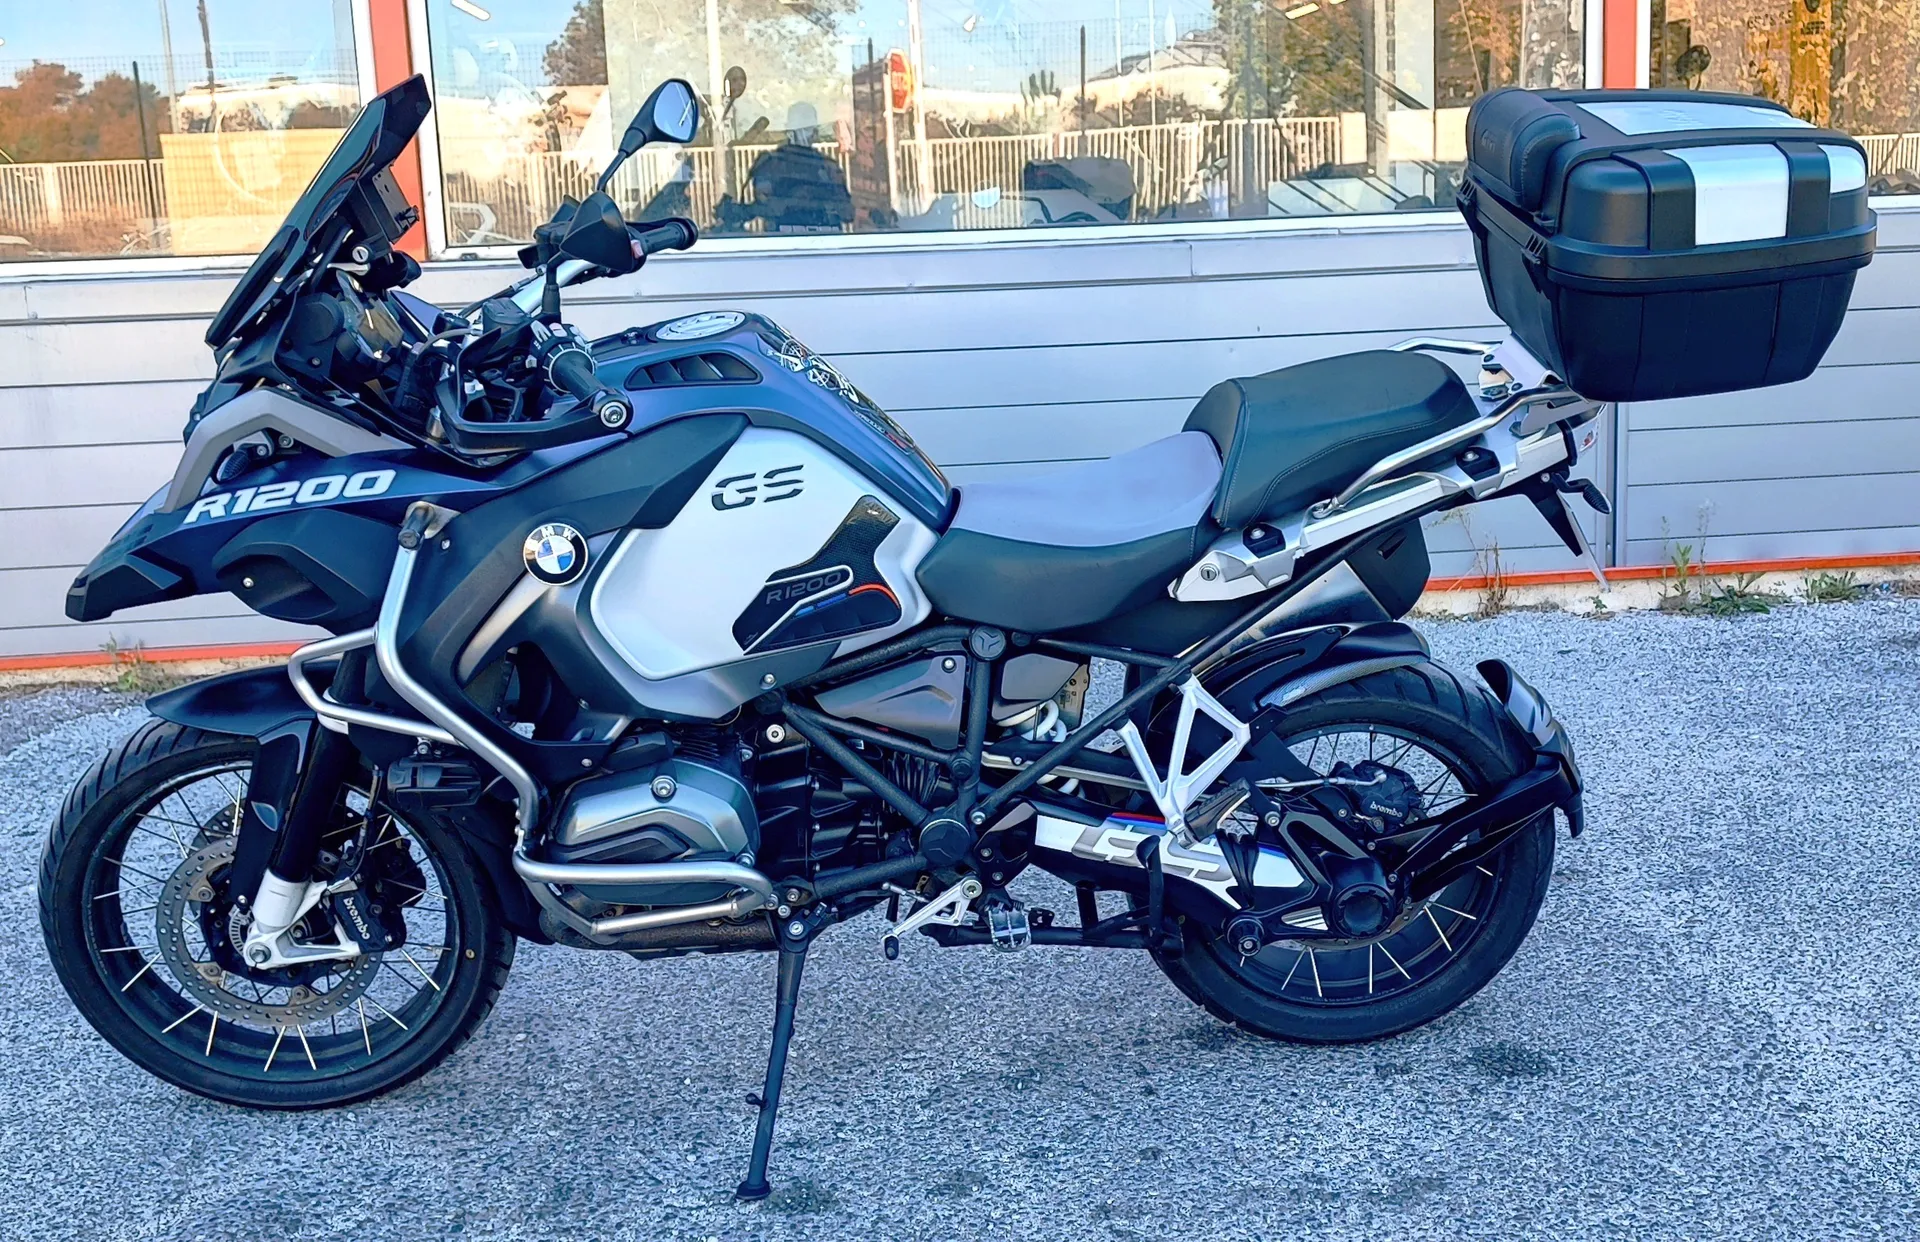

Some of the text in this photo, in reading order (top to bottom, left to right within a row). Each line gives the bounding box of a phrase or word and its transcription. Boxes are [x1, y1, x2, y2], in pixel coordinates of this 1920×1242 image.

[183, 469, 397, 524] R1200
[711, 464, 804, 511] GS
[766, 572, 842, 605] R1200
[1370, 800, 1403, 818] brembo
[343, 896, 371, 940] brembo
